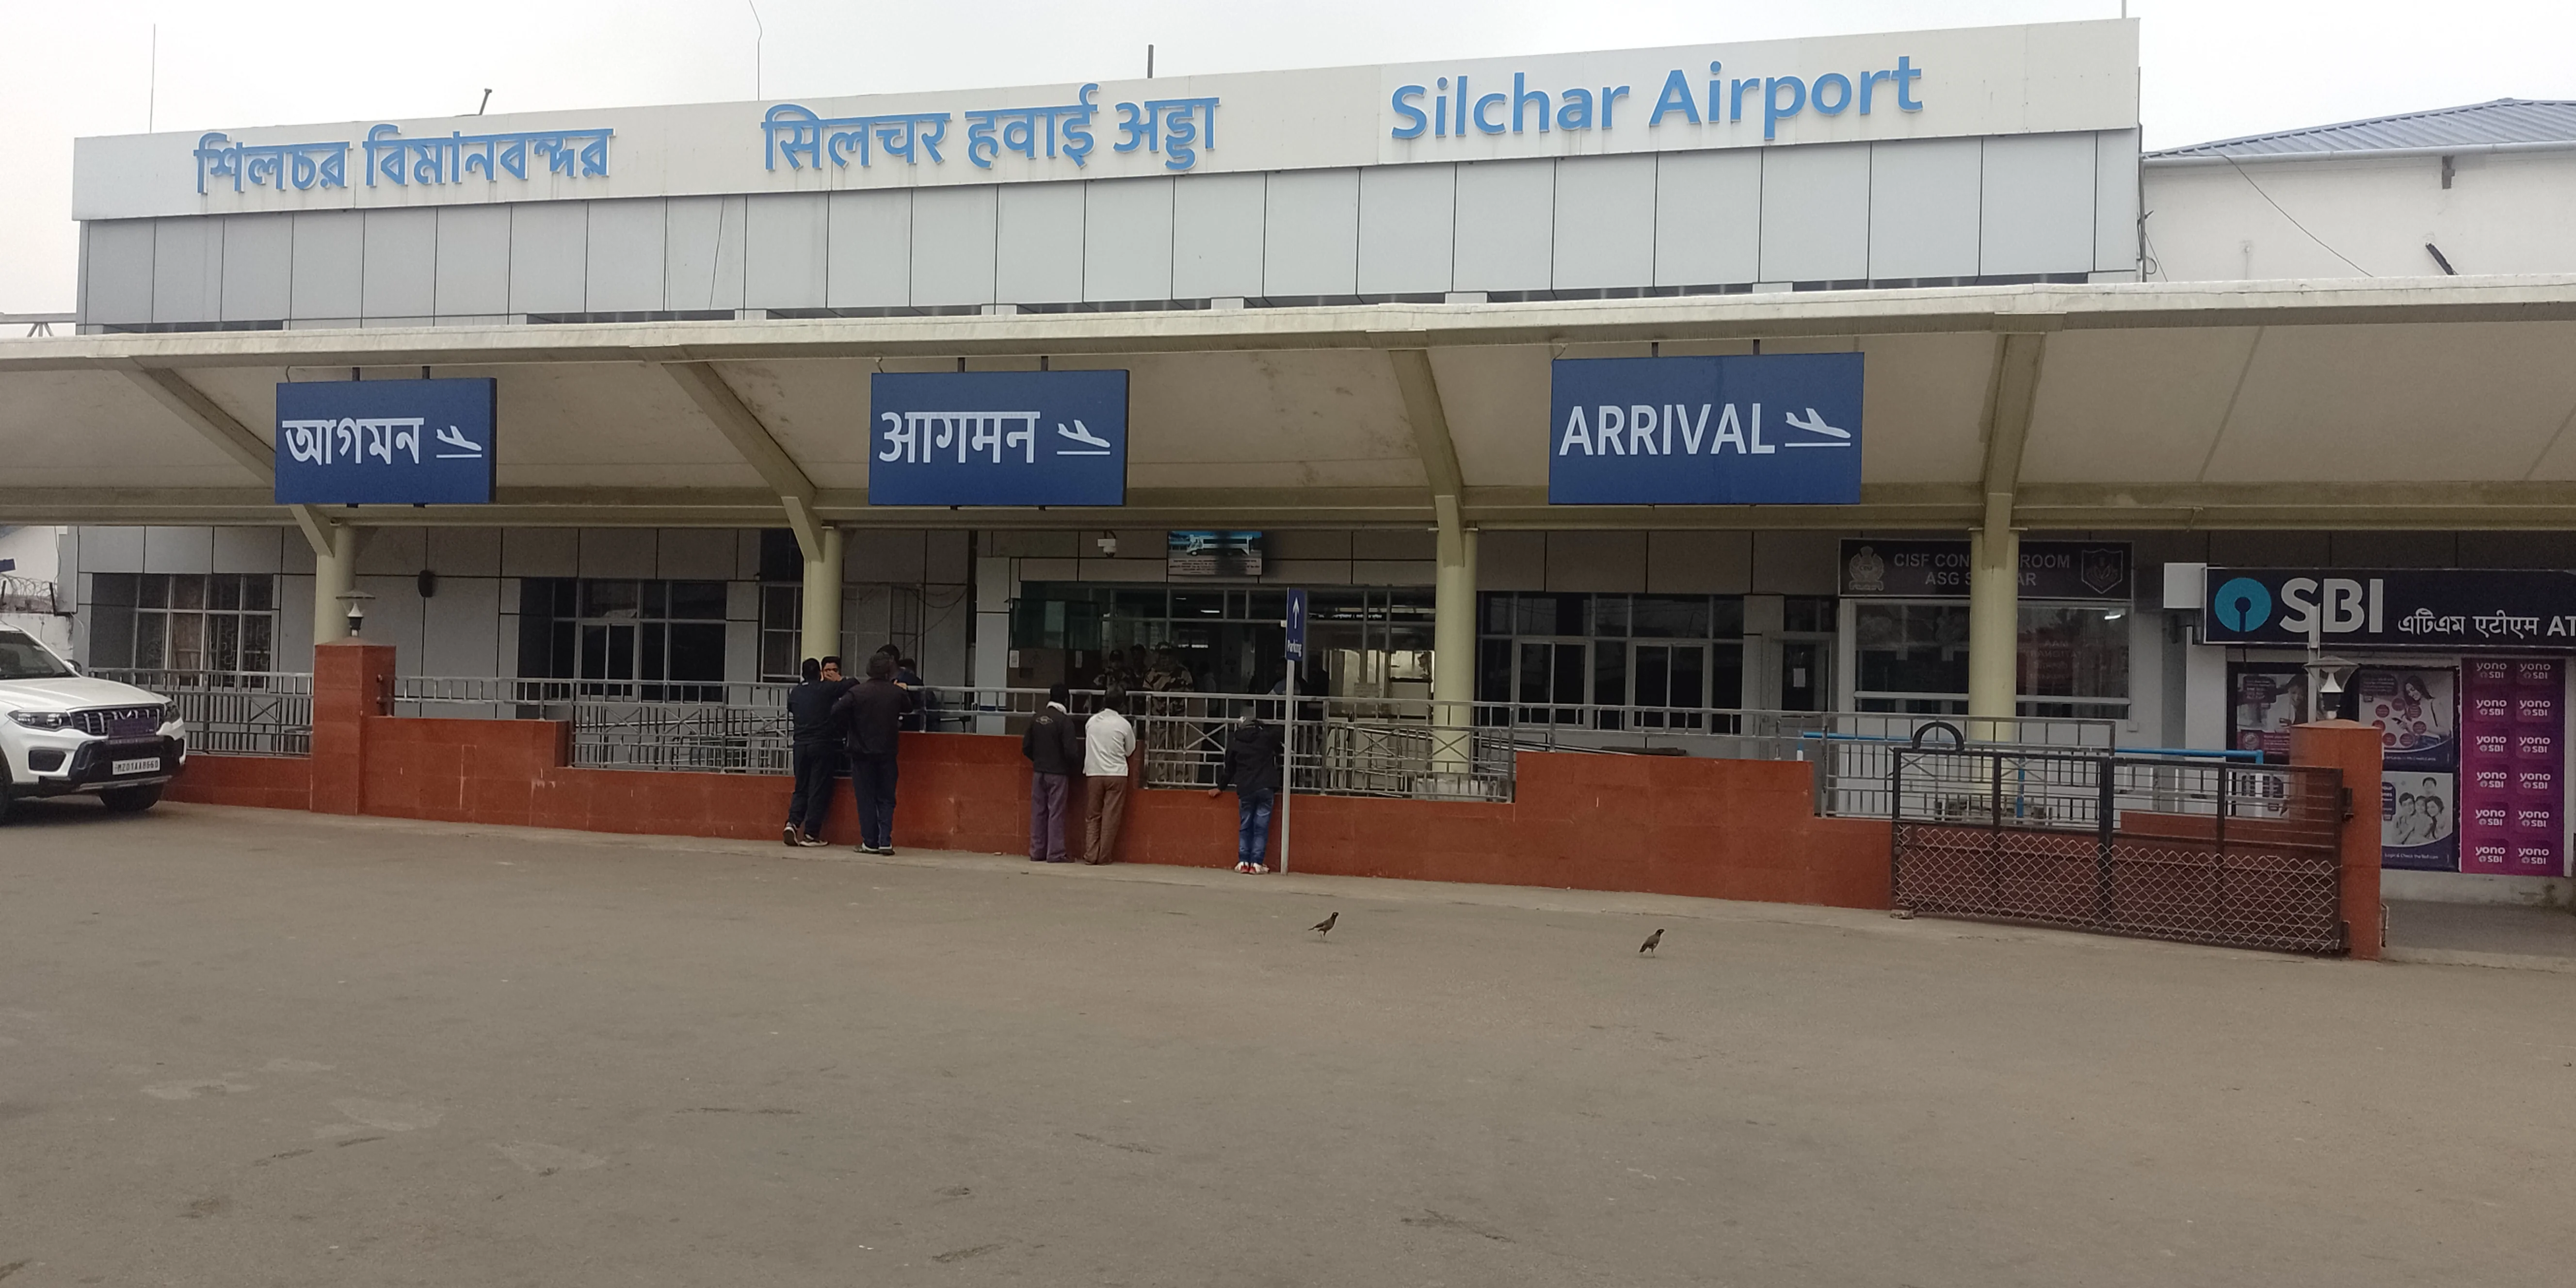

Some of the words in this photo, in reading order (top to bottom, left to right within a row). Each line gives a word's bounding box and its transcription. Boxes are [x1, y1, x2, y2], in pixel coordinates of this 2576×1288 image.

[1391, 72, 1629, 139] Silchar
[1650, 56, 1922, 140] Airport
[761, 104, 950, 171] सिलचर
[965, 83, 1099, 168] हवाई
[1113, 97, 1220, 170] अड्डा
[194, 132, 352, 193] শিলচর
[362, 124, 614, 187] বিমানবন্দর
[1559, 403, 1775, 455] ARRIVAL
[282, 418, 424, 465] আগমন
[879, 412, 1041, 463] आगमन
[1894, 553, 1930, 567] CISF
[2020, 554, 2070, 568] ROOM
[1925, 571, 1959, 585] ASG
[2279, 578, 2383, 633] SBI
[2398, 608, 2465, 635] এটিএম
[2472, 610, 2540, 639] एटीएम
[2477, 662, 2507, 672] yono
[2520, 663, 2551, 672] yono
[2476, 700, 2507, 708] yono
[2519, 700, 2551, 709] yono
[2476, 736, 2507, 745] yono
[2519, 737, 2550, 746] yono
[2477, 772, 2507, 781] yono
[2520, 773, 2551, 782] yono
[2476, 809, 2506, 819] yono
[2518, 810, 2549, 820] yono
[2476, 846, 2506, 856] yono
[2518, 848, 2549, 857] yono
